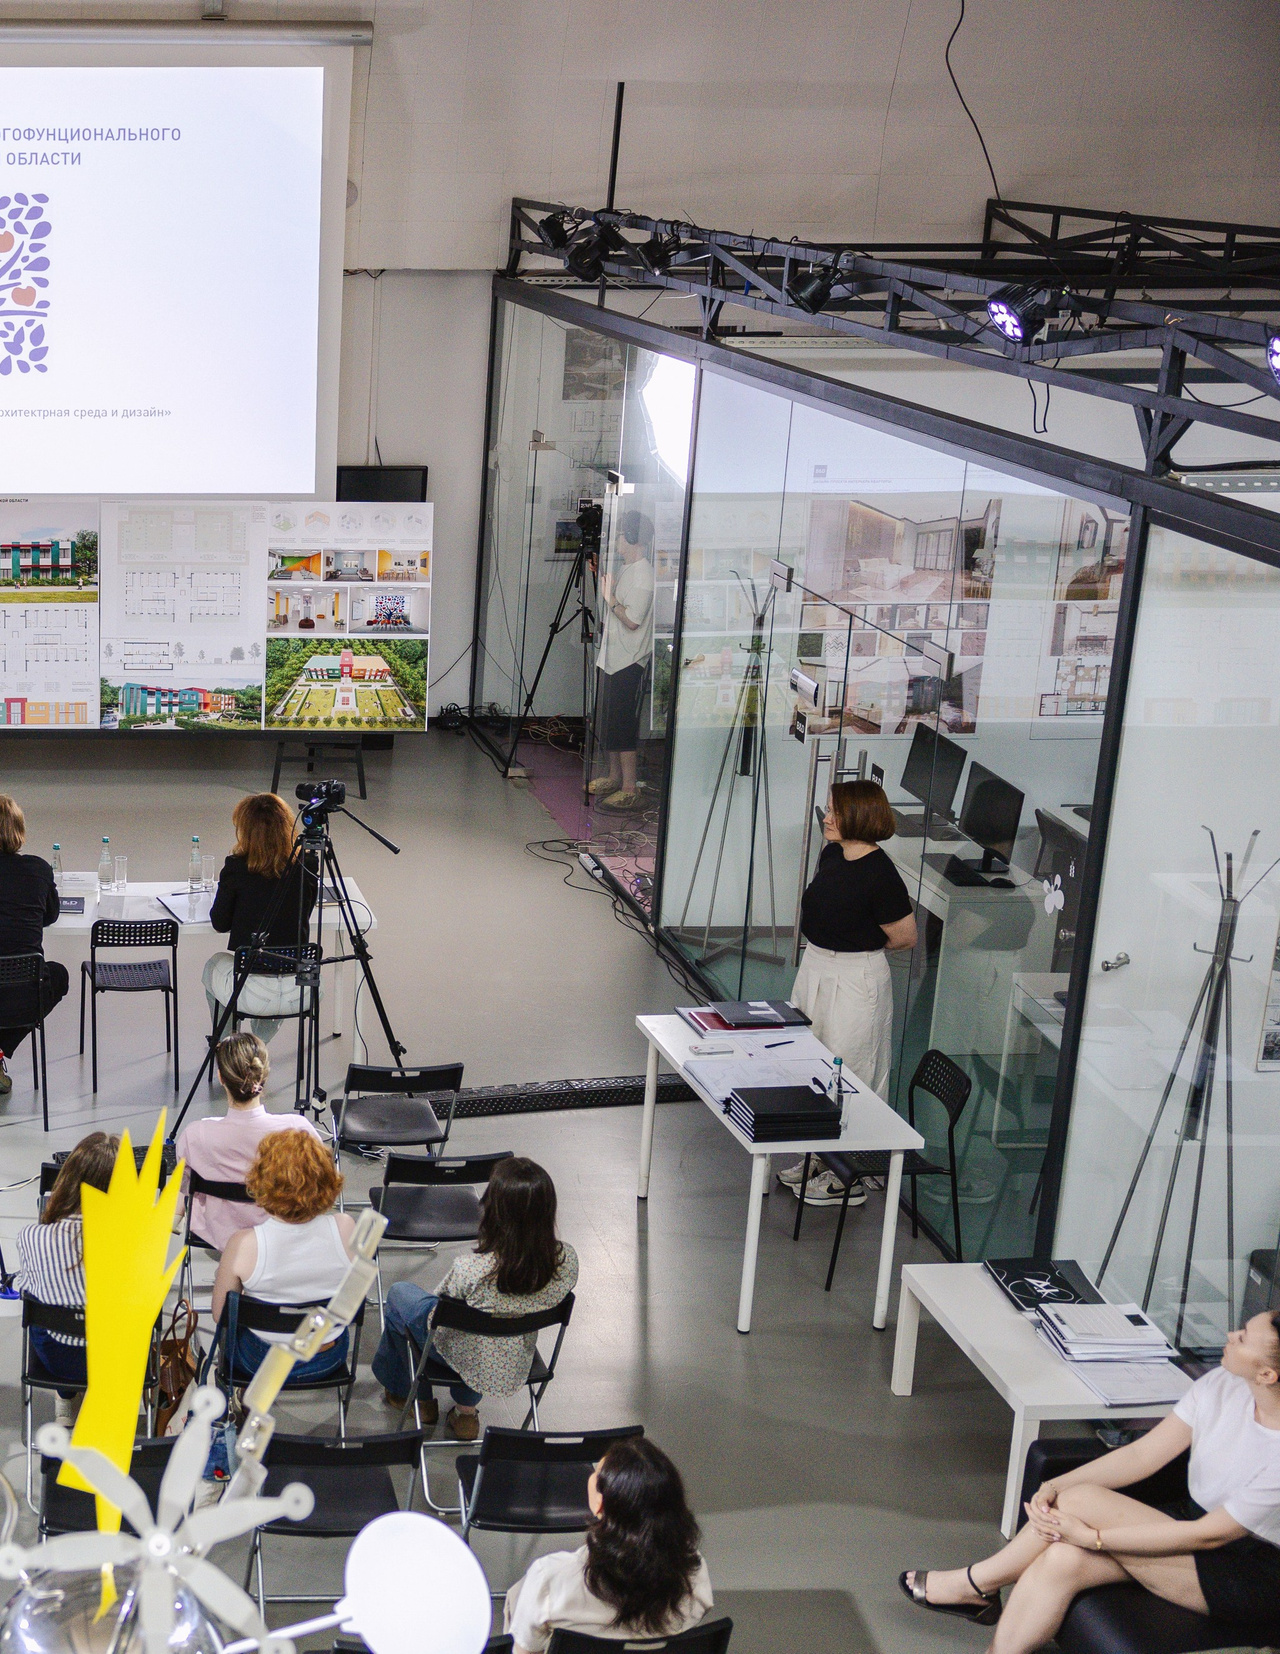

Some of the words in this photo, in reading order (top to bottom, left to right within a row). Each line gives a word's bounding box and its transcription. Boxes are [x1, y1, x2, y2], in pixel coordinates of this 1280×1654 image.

[6, 152, 82, 166] ОБЛАСТИ
[73, 409, 108, 419] среда
[111, 409, 119, 418] и
[121, 407, 172, 419] дизайн»
